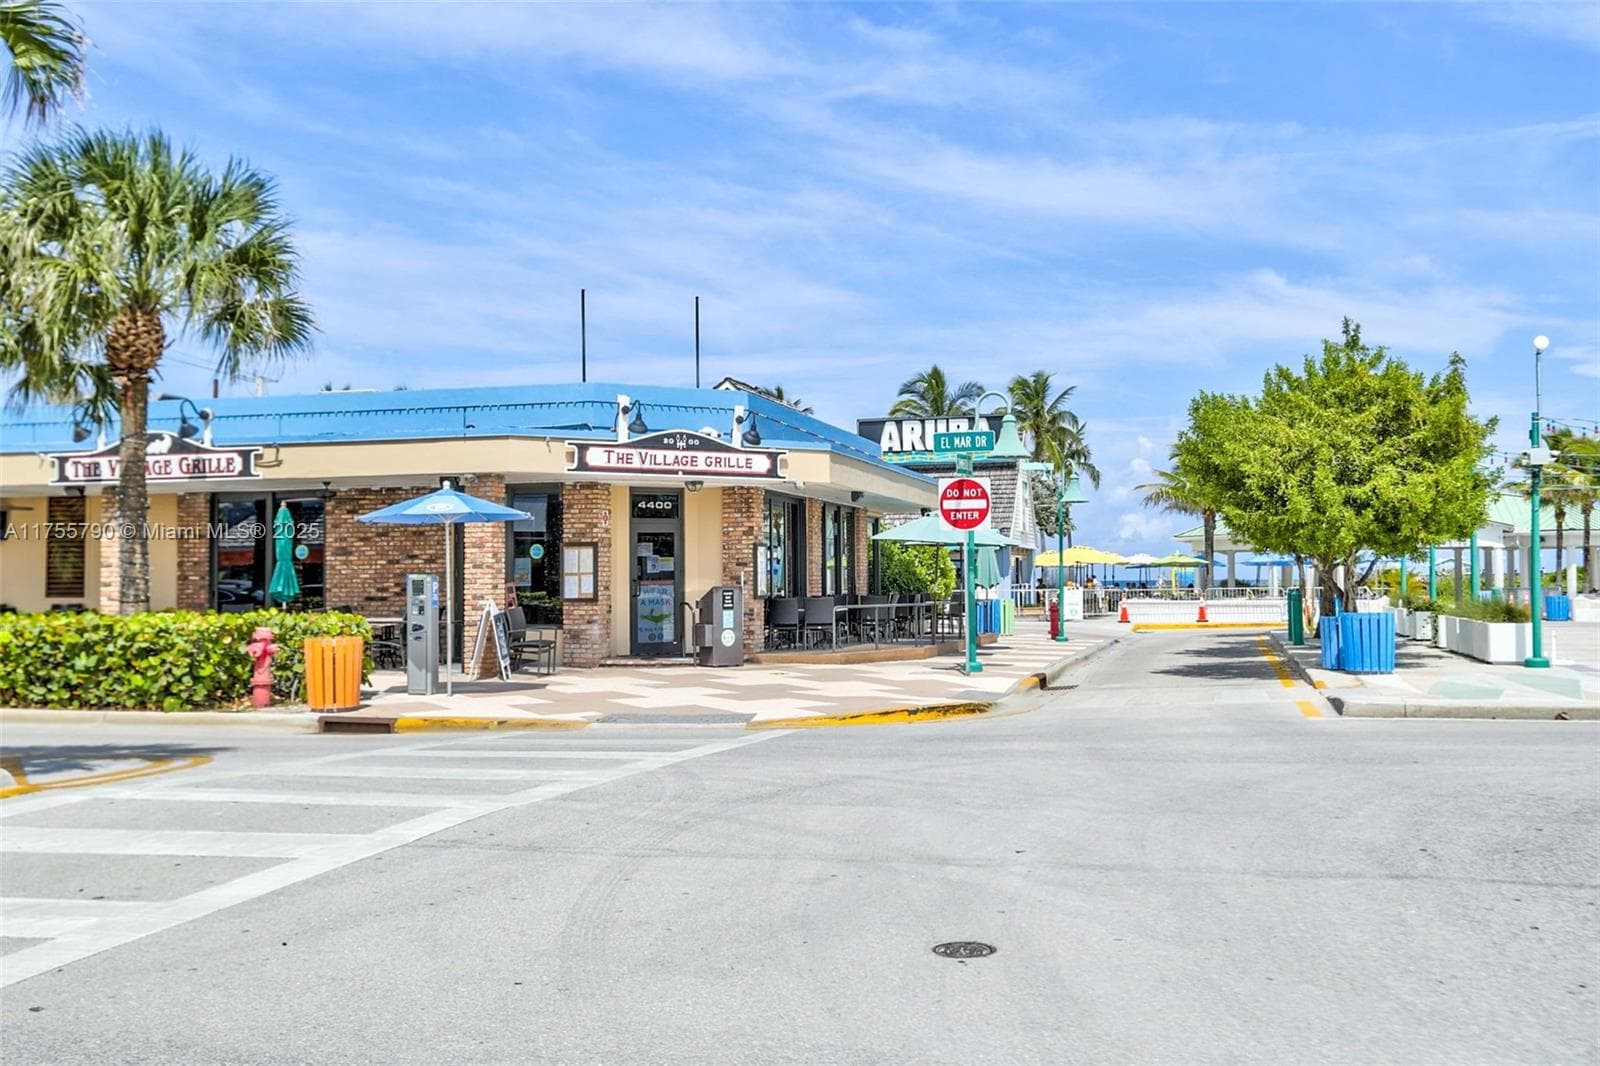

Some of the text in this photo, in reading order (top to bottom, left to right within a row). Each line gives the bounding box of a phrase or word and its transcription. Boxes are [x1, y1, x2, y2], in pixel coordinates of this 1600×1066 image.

[940, 435, 988, 449] EL MAR DR
[604, 449, 753, 470] THE VILLAGE GRILLE
[72, 456, 236, 478] THE VAGE GRILLE
[946, 488, 982, 498] DO NOT
[638, 501, 672, 510] 4400
[950, 511, 980, 521] ENTER
